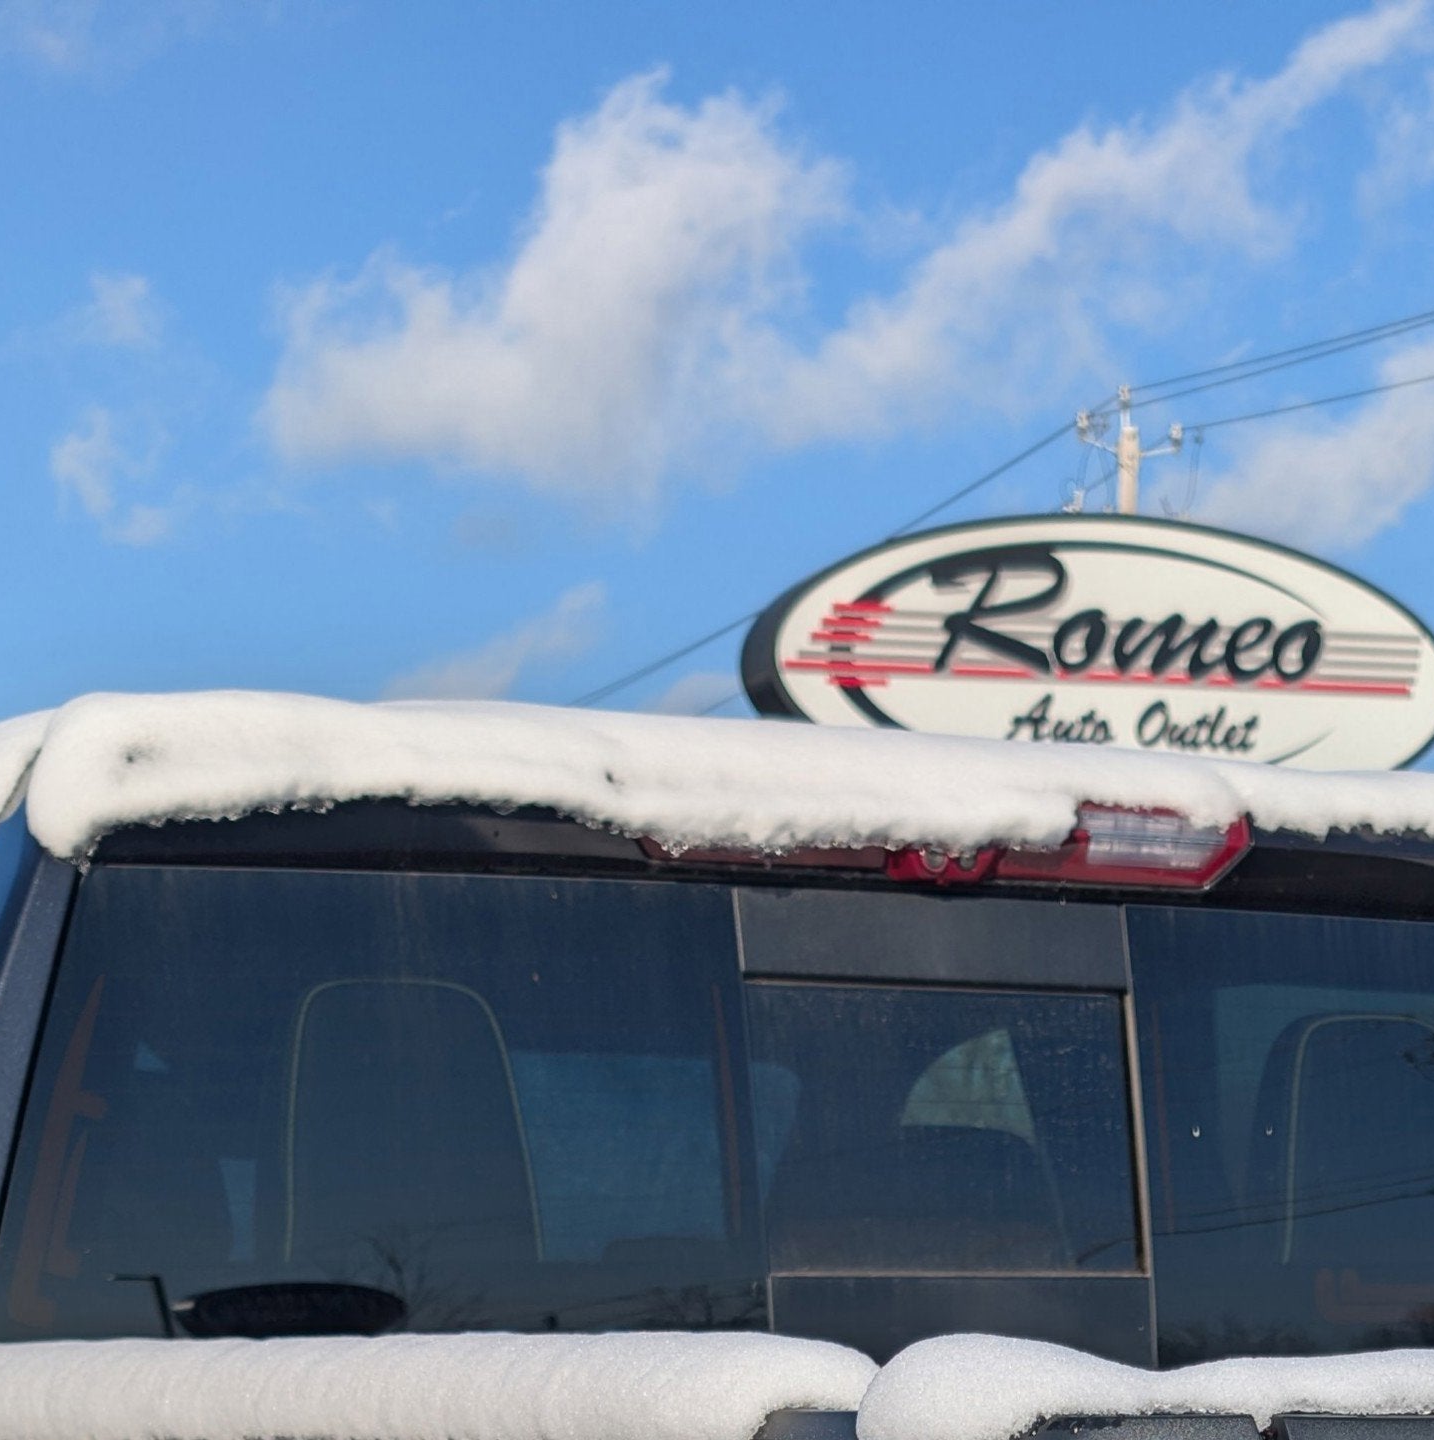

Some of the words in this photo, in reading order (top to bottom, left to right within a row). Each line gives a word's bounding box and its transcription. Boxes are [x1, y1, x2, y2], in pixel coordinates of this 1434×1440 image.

[927, 543, 1324, 682] Romeo
[1006, 693, 1115, 744] Auto
[1136, 700, 1259, 751] Outlet
